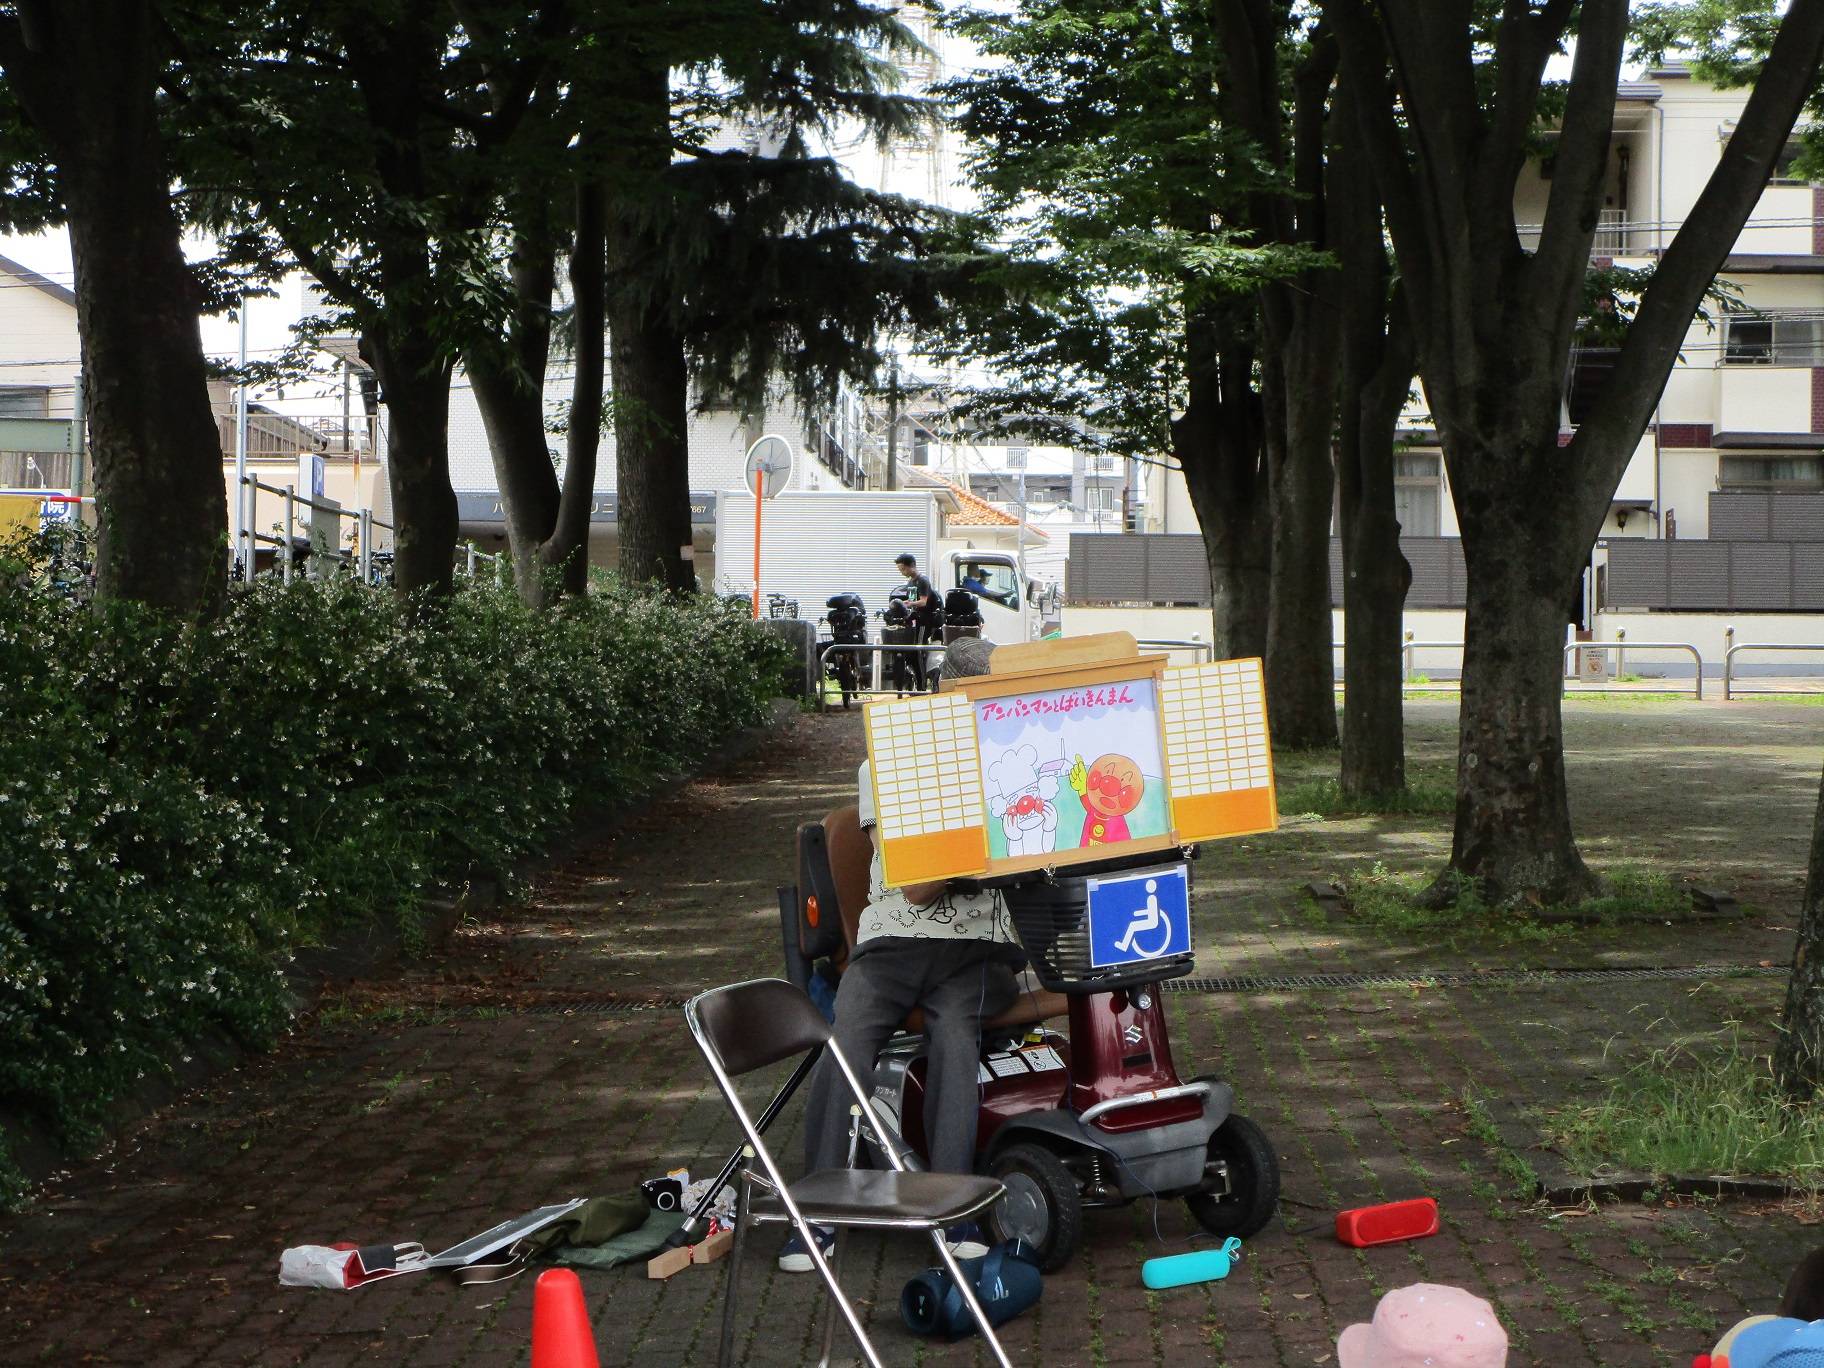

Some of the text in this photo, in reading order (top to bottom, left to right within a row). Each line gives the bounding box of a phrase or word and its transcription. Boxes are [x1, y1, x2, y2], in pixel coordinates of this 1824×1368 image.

[982, 685, 1134, 721] アンパンマンとばいきんまん
